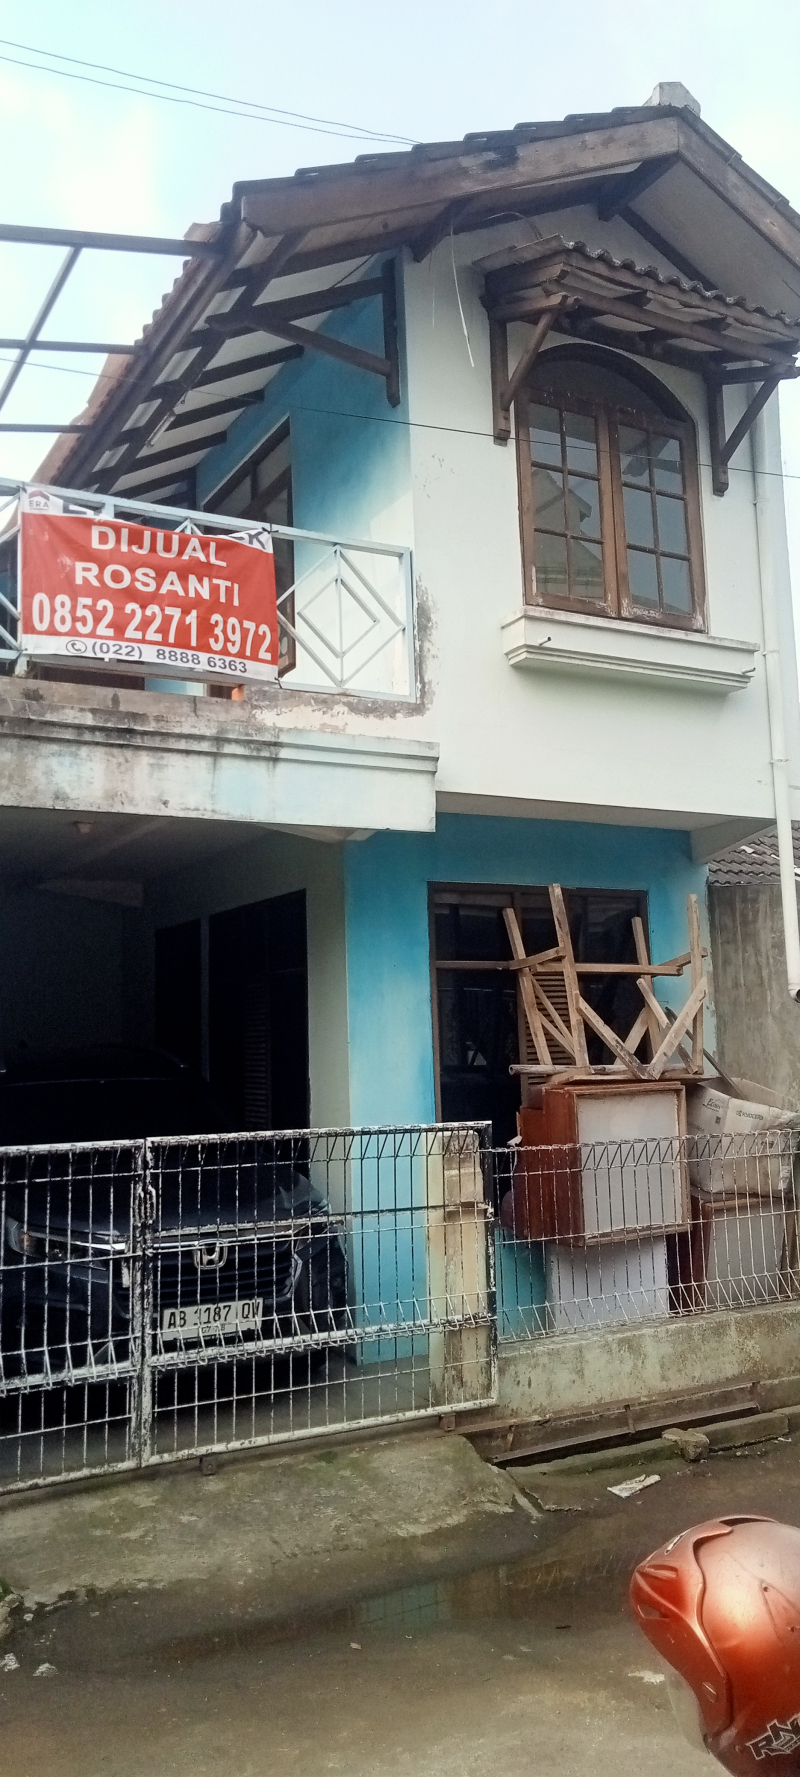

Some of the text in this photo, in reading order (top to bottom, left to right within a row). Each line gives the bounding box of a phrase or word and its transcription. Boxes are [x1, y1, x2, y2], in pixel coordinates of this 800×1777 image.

[28, 500, 49, 509] ERA
[91, 525, 227, 567] DIJUAL
[75, 561, 239, 606] ROSANTI
[32, 592, 272, 661] 0852 2271 3972
[91, 641, 248, 674] (022) 8888 6363
[167, 1311, 187, 1329] AB
